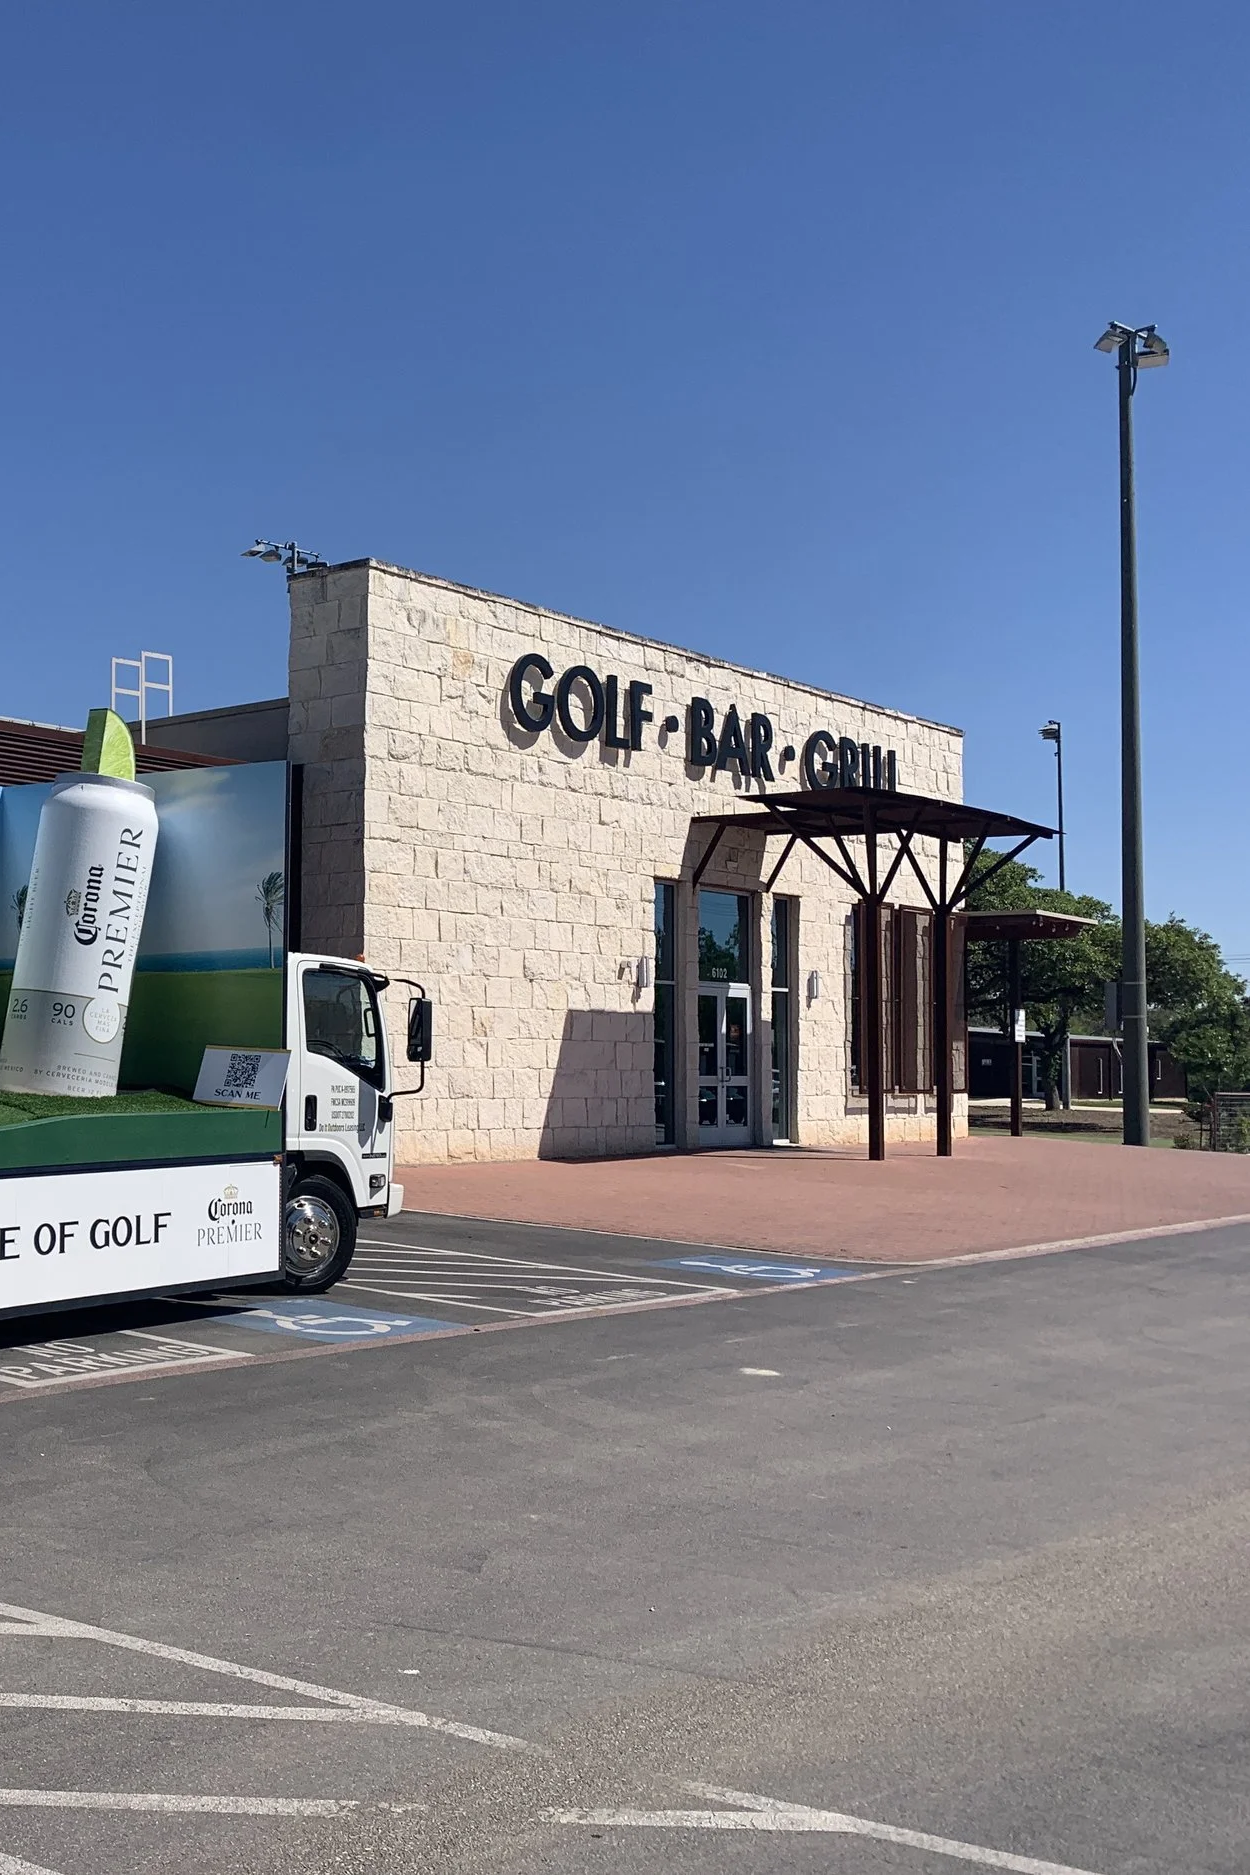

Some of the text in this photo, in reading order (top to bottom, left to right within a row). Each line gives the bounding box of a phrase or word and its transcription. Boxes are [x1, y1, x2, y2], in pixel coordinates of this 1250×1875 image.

[509, 653, 653, 751] GOLF
[690, 696, 775, 782] BAR
[74, 864, 105, 946] Corona
[98, 827, 143, 993] PREMIER
[711, 967, 728, 979] 6102
[12, 998, 28, 1013] 2.6
[52, 1002, 76, 1019] 90
[51, 1018, 74, 1026] CALS
[56, 1064, 87, 1075] BREWED
[214, 1088, 261, 1100] SCAN ME
[208, 1197, 253, 1223] Corona
[33, 1220, 80, 1256] OF
[89, 1212, 172, 1250] GOLF
[197, 1222, 263, 1247] PREMIER
